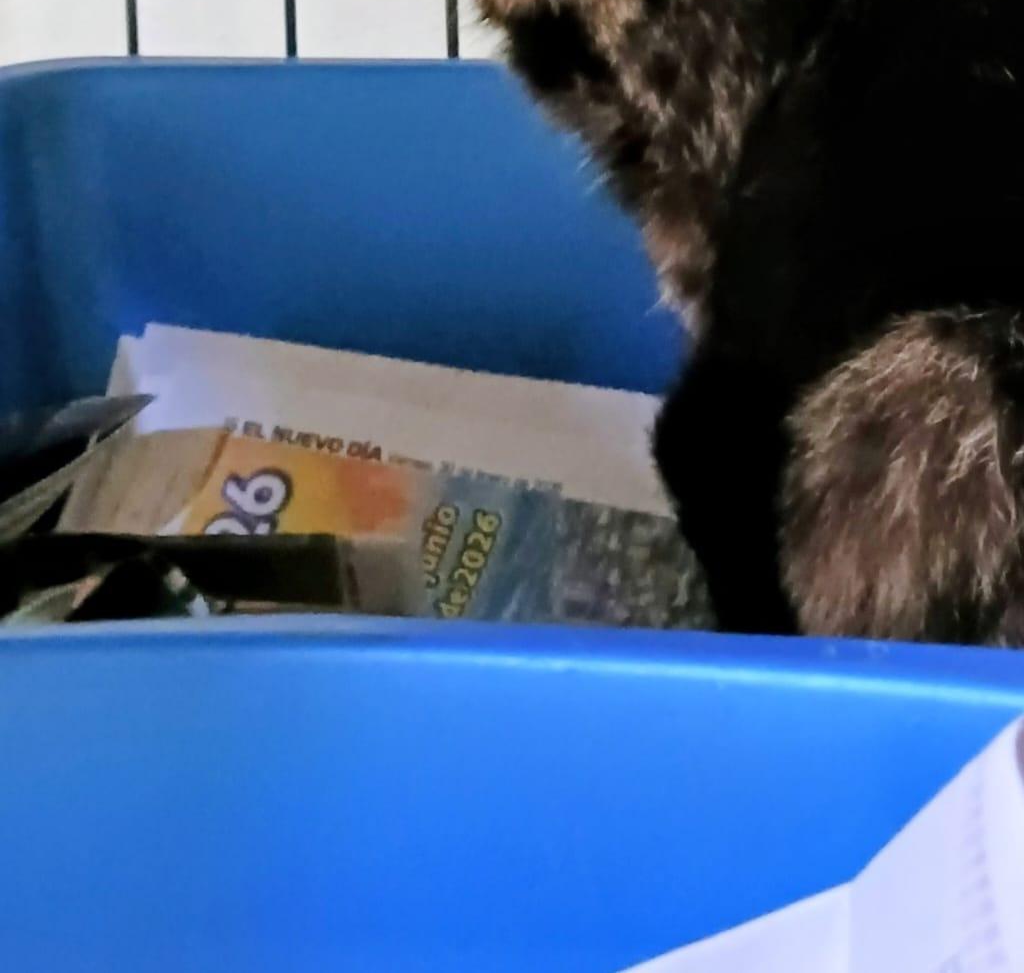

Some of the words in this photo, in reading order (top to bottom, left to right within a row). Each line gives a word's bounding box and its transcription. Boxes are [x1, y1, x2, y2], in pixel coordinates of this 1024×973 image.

[243, 421, 265, 439] EL
[271, 426, 343, 454] NUEVO
[346, 440, 382, 461] DÍA
[452, 509, 501, 587] 2026
